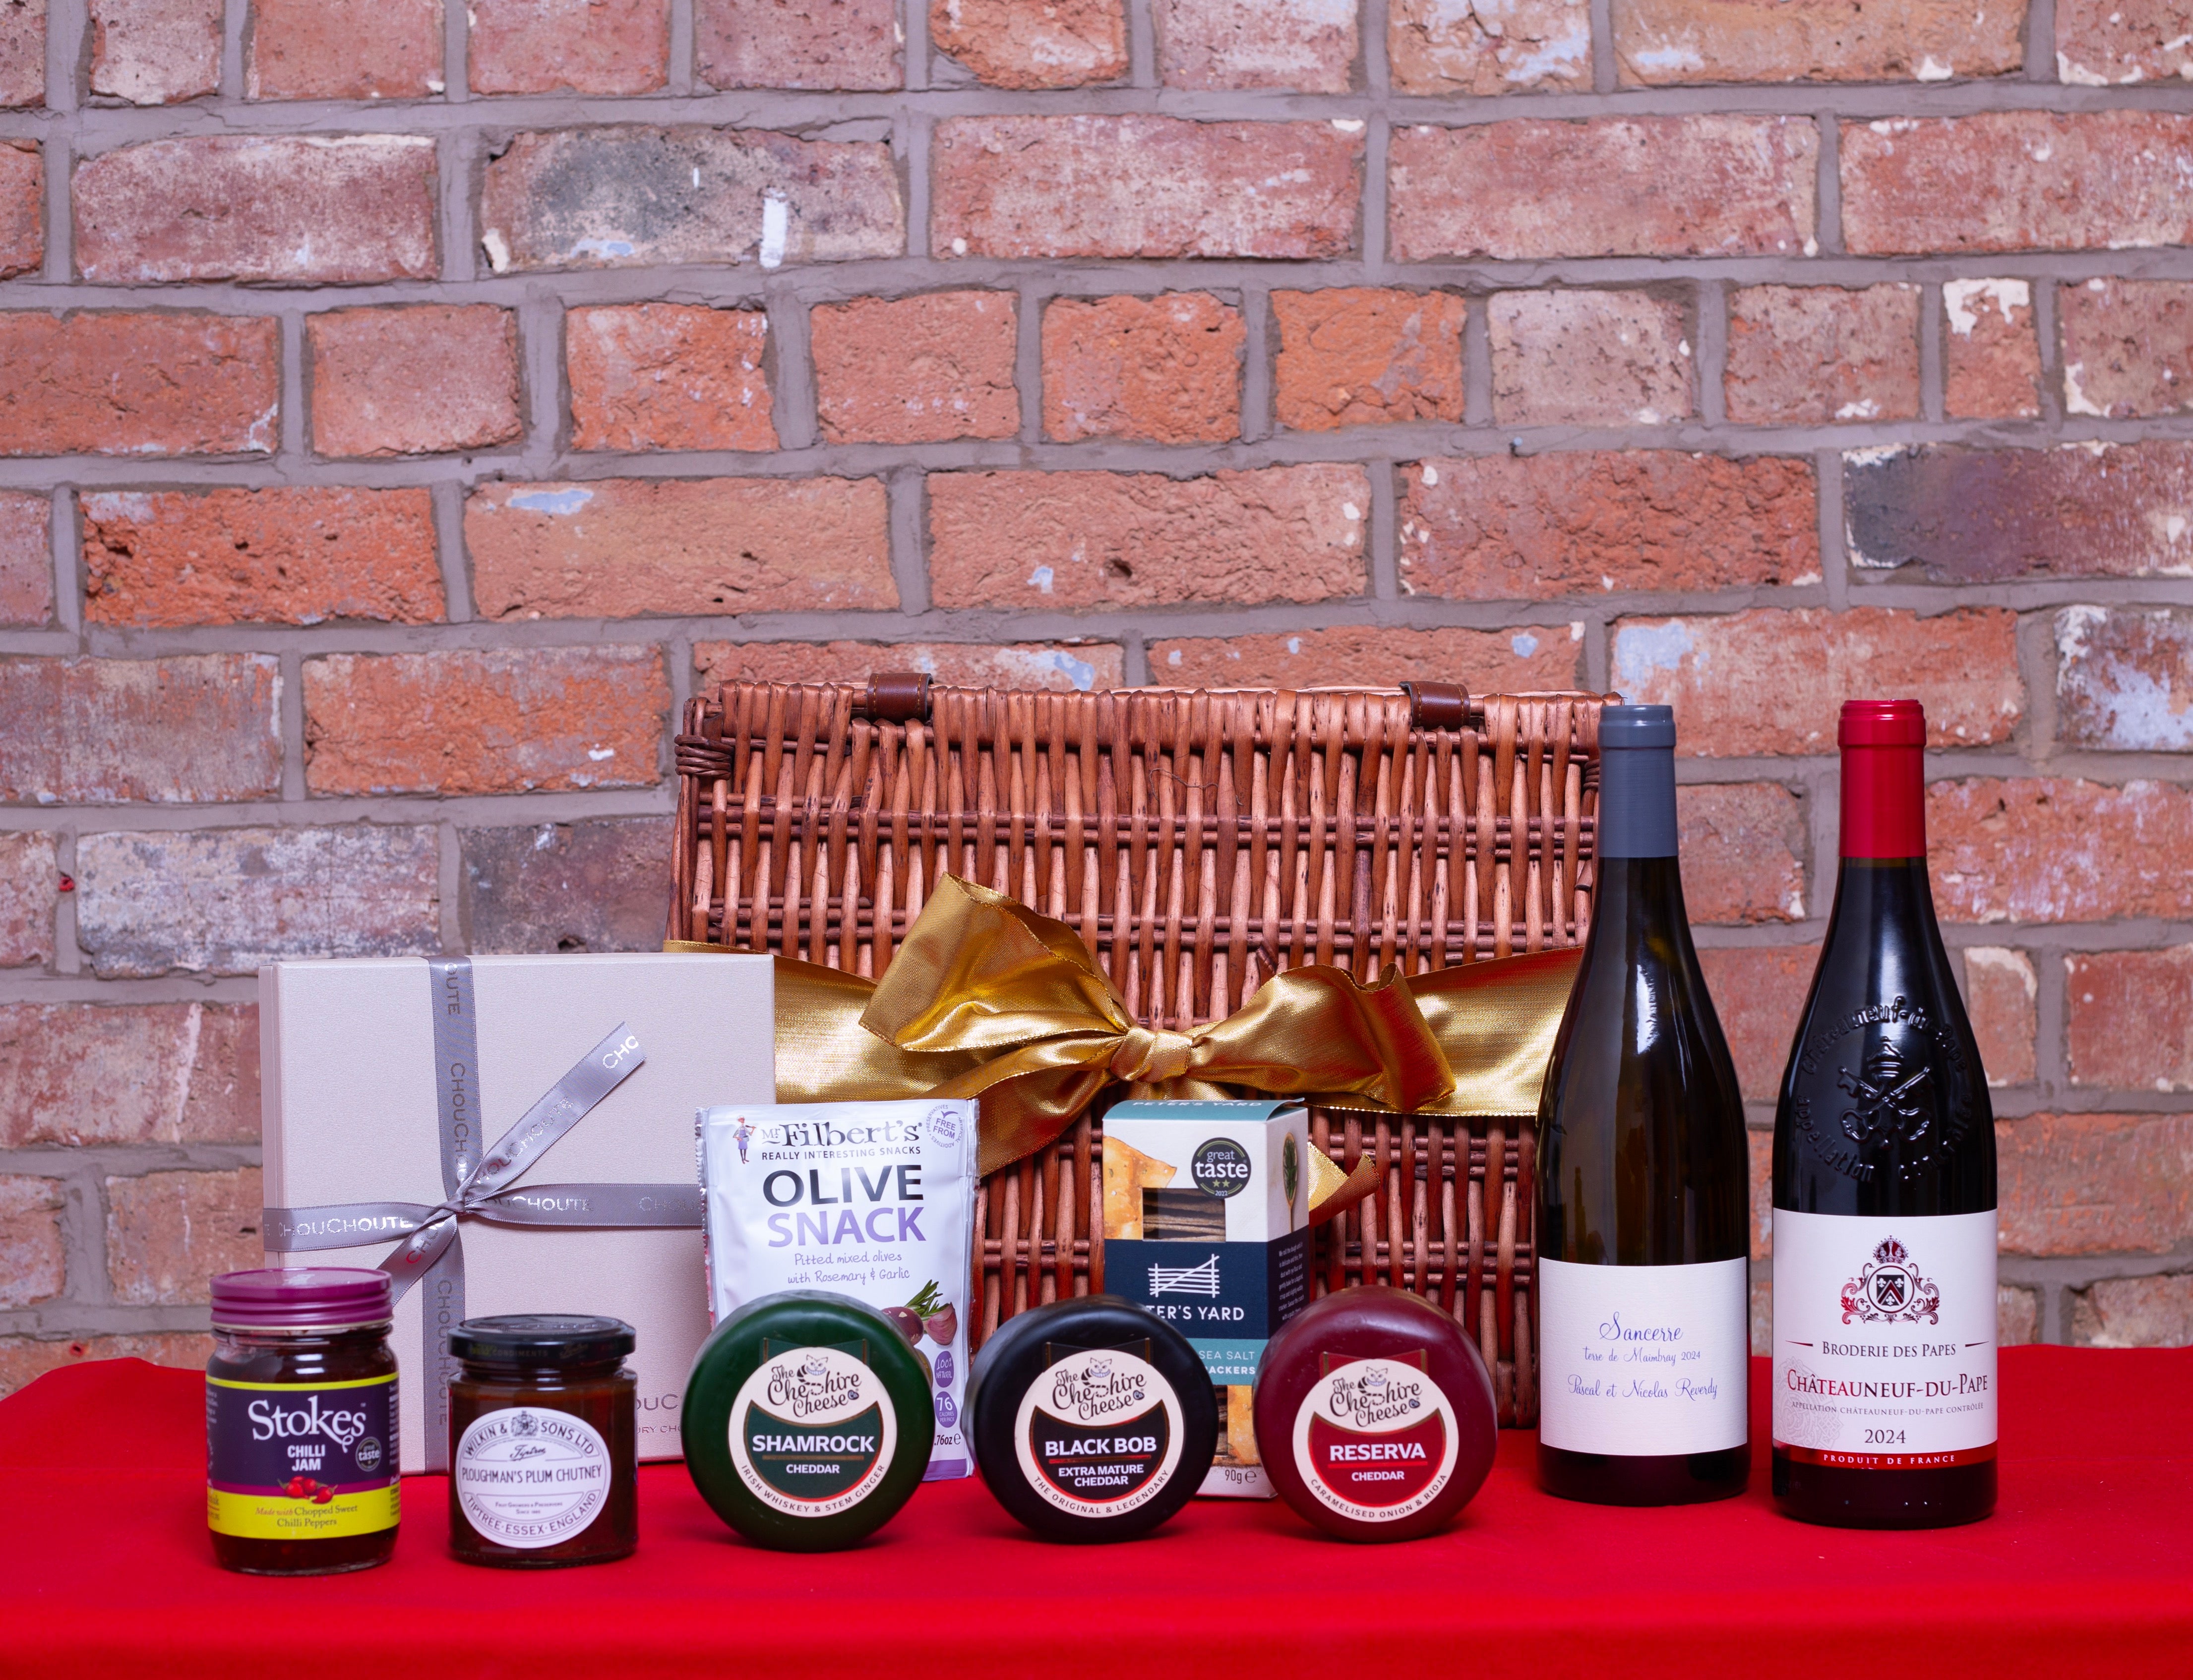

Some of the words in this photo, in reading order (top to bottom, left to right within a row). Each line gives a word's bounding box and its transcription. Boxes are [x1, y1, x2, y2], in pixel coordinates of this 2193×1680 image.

[933, 1126, 955, 1139] FROM
[936, 1118, 956, 1131] FREE
[762, 1150, 800, 1160] REALLY
[804, 1148, 875, 1159] INTERESTING
[880, 1146, 921, 1156] SNACKS
[1207, 1150, 1235, 1162] great
[1195, 1161, 1248, 1178] taste
[762, 1164, 924, 1207] OLIVE
[279, 1217, 413, 1237] CHOUCHOUTE
[767, 1206, 926, 1248] SNACK
[794, 1252, 834, 1266] Pitted
[837, 1250, 870, 1263] mixed
[873, 1250, 902, 1262] olives
[788, 1271, 811, 1284] with
[815, 1270, 866, 1285] Rosemary
[870, 1268, 876, 1280] &
[879, 1267, 910, 1280] Garlic
[1198, 1307, 1244, 1320] YARD
[1599, 1311, 1683, 1342] Sancerre
[1199, 1350, 1222, 1360] SEA
[1226, 1351, 1255, 1360] SALT
[1583, 1346, 1604, 1362] terre
[1609, 1348, 1618, 1362] de
[1623, 1347, 1676, 1366] Maimbray
[1681, 1350, 1701, 1361] 2024
[1893, 1346, 1917, 1358] DES
[937, 1358, 952, 1369] 100%
[1207, 1366, 1255, 1375] ACKERS
[772, 1365, 794, 1382] The
[1055, 1369, 1080, 1386] The
[1332, 1378, 1356, 1395] The
[1568, 1374, 1601, 1397] Pascal
[1606, 1384, 1617, 1397] et
[1622, 1380, 1668, 1398] Nicolas
[1674, 1378, 1718, 1401] Reverdy
[793, 1392, 849, 1417] Cheese
[936, 1397, 953, 1411] 76
[1079, 1394, 1134, 1420] Cheese
[1792, 1401, 1837, 1413] APPELLATION
[1840, 1405, 1944, 1416] CHÂTEAUNEUF-DU-PAPE
[1946, 1401, 1984, 1414] CONTRÔLÉE
[1355, 1402, 1409, 1427] Cheese
[248, 1395, 366, 1453] Stokes
[466, 1426, 495, 1456] WILKIN
[500, 1424, 507, 1434] &
[541, 1422, 574, 1444] SONS
[576, 1436, 594, 1454] LTD
[752, 1435, 875, 1452] SHAMROCK
[1865, 1429, 1906, 1444] 2024
[288, 1444, 325, 1458] CHILLI
[1045, 1438, 1110, 1456] BLACK
[1114, 1437, 1157, 1453] BOB
[1330, 1443, 1426, 1461] RESERVA
[358, 1450, 380, 1461] taste
[1824, 1454, 1879, 1464] PRODUIT
[1887, 1456, 1902, 1465] DE
[1910, 1454, 1955, 1464] FRANCE
[292, 1458, 321, 1471] JAM
[786, 1463, 840, 1474] CHEDDAR
[1058, 1466, 1096, 1477] EXTRA
[1097, 1464, 1144, 1475] MATURE
[462, 1467, 523, 1483] PLOUGHMAN'S
[526, 1470, 552, 1483] PLUM
[556, 1464, 602, 1481] CHUTNEY
[1074, 1476, 1129, 1487] CHEDDAR
[1225, 1469, 1242, 1484] 90g
[1351, 1471, 1404, 1481] CHEDDAR
[741, 1465, 762, 1491] IRISH
[764, 1492, 810, 1513] WHISKEY
[825, 1497, 853, 1511] STEM
[856, 1464, 885, 1498] GINGER
[1034, 1476, 1050, 1495] THE
[1052, 1494, 1101, 1514] ORIGINAL
[1116, 1469, 1169, 1512] LEGENDARY
[1311, 1478, 1375, 1518] CARAMELISED
[1379, 1504, 1413, 1519] ONION
[1415, 1499, 1422, 1507] &
[1424, 1474, 1447, 1500] RIOJA
[277, 1507, 293, 1515] with
[294, 1506, 333, 1517] Chopped
[335, 1505, 358, 1513] Sweet
[467, 1497, 500, 1531] TIPTREE
[505, 1523, 544, 1535] ESSEX
[550, 1493, 596, 1532] ENGLAND
[277, 1518, 302, 1527] Chilli
[304, 1518, 337, 1528] Peppers
